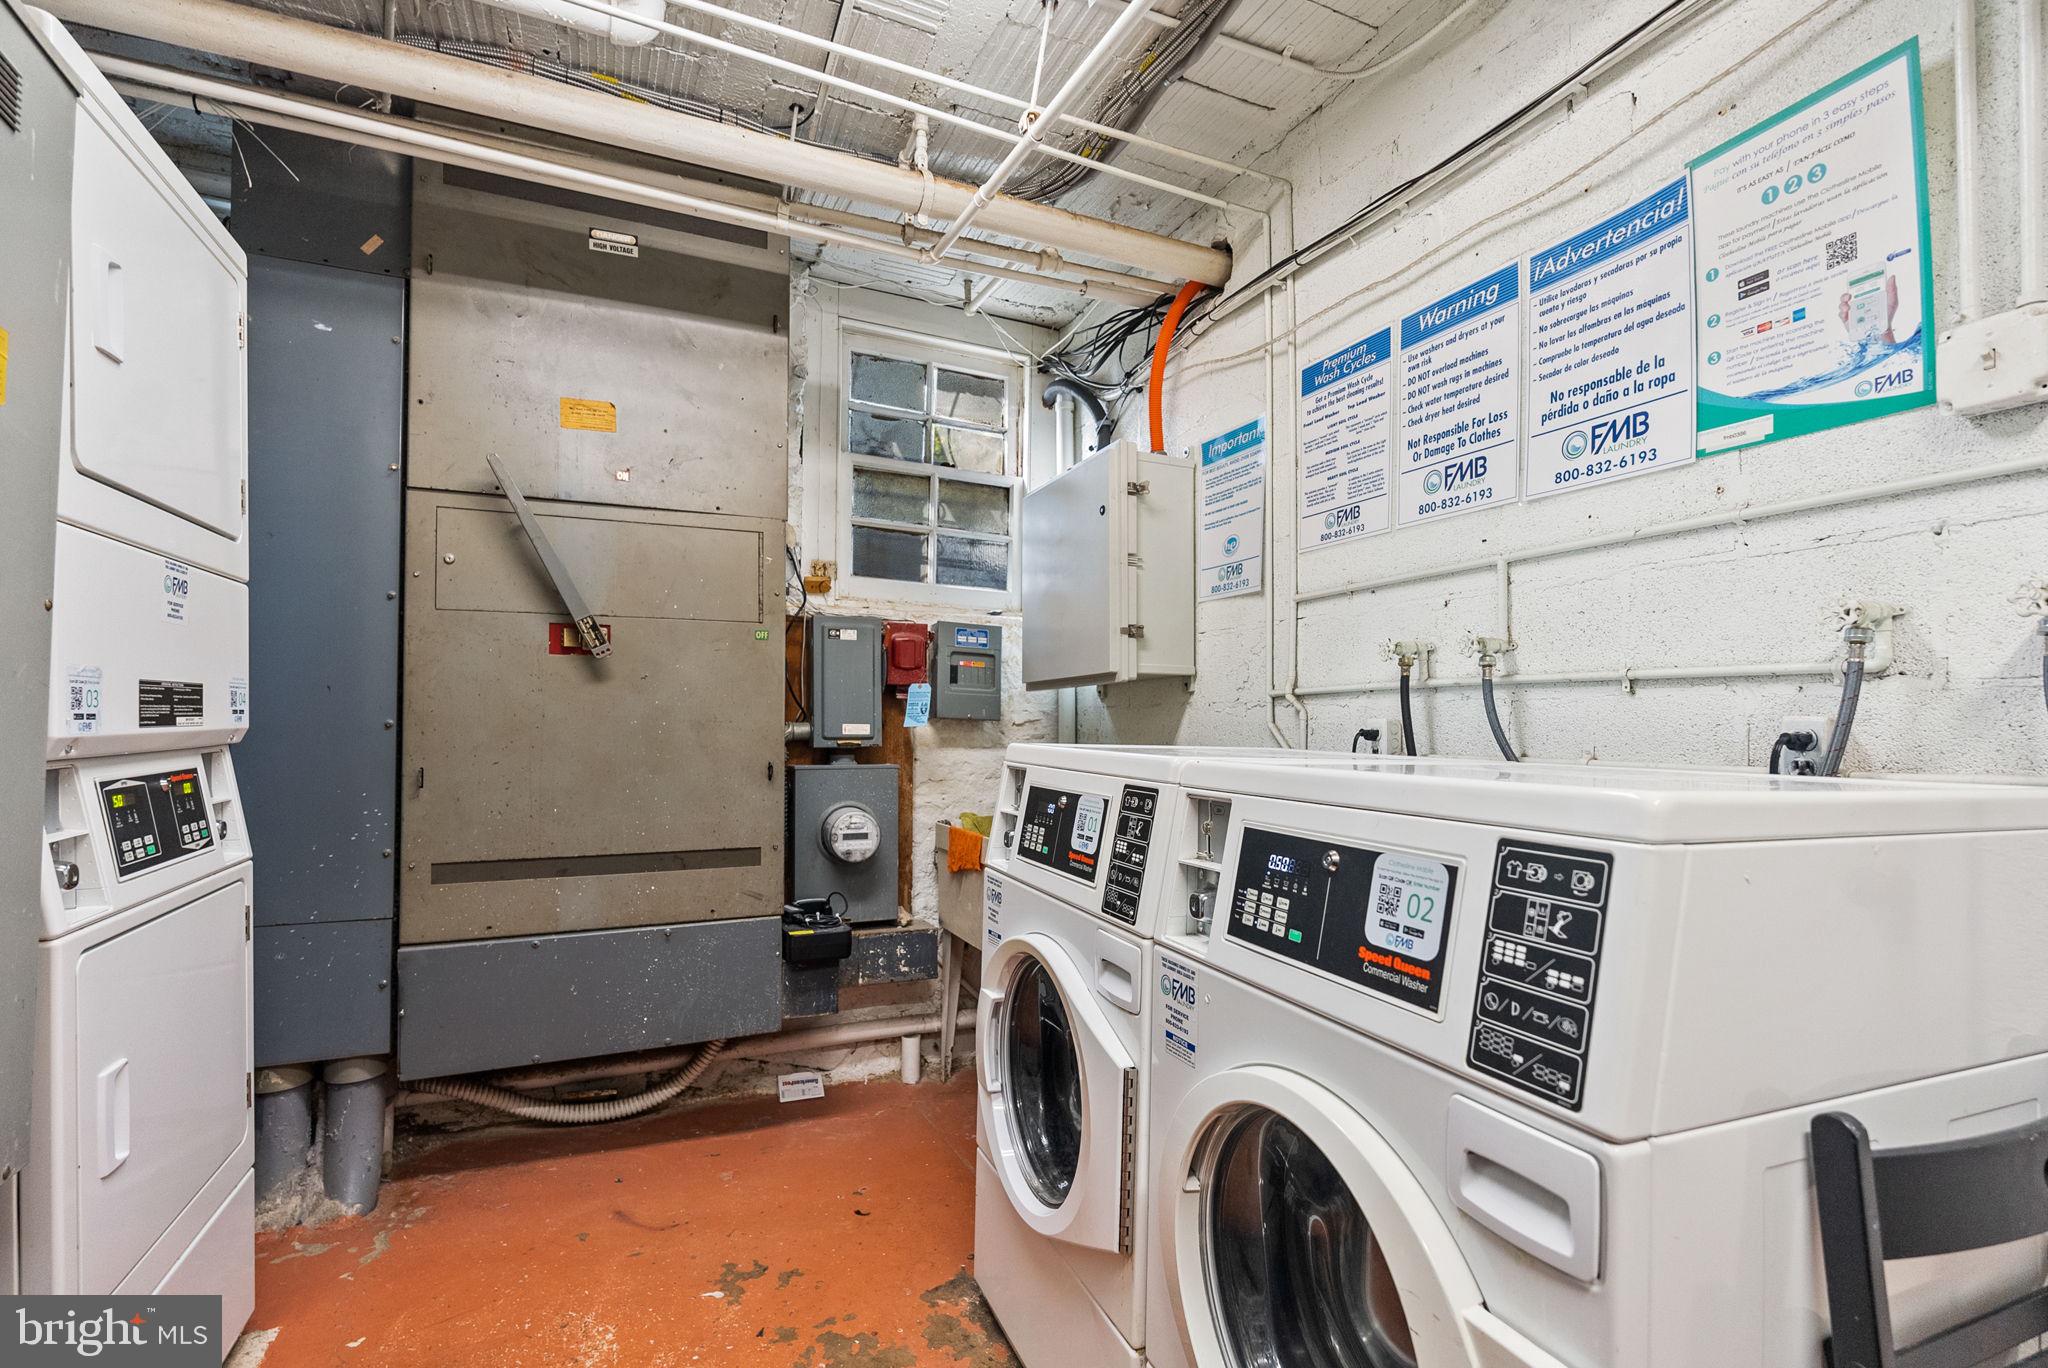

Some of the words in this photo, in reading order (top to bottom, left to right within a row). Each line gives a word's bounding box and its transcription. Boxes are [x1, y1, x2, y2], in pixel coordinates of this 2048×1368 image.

[1714, 166, 1731, 180] Pay
[1732, 154, 1751, 167] with
[1753, 141, 1774, 159] your
[1777, 124, 1809, 146] phone
[1812, 117, 1822, 128] in
[1824, 109, 1830, 120] 3
[1833, 98, 1857, 115] easy
[1860, 81, 1889, 100] steps
[1732, 168, 1747, 180] con
[1750, 161, 1760, 171] su
[1803, 133, 1814, 144] en
[1825, 107, 1863, 132] simples
[1866, 91, 1896, 115] pasos
[1767, 189, 1774, 202] 1
[1789, 177, 1798, 191] 2
[1813, 166, 1822, 181] 3
[593, 242, 607, 250] HIGH
[609, 244, 633, 254] VOLTAGE
[1539, 294, 1559, 307] Utilice
[1560, 279, 1592, 300] lavadoras
[1594, 275, 1598, 284] y
[1600, 260, 1634, 279] secadoras
[1636, 254, 1648, 267] por
[1650, 249, 1658, 257] su
[1660, 235, 1683, 254] propia
[1420, 283, 1499, 331] Warning
[1539, 305, 1559, 317] cuenta
[1561, 302, 1565, 311] y
[1567, 293, 1587, 306] riesgo
[1539, 325, 1548, 333] No
[1550, 308, 1588, 329] sobrecargue
[1589, 304, 1599, 313] las
[1407, 354, 1418, 363] Use
[1420, 342, 1444, 357] washers
[1446, 335, 1456, 346] and
[1458, 327, 1478, 341] dryers
[1481, 322, 1487, 331] at
[1490, 315, 1505, 329] your
[1539, 340, 1548, 349] No
[1550, 334, 1566, 344] lavar
[1567, 329, 1577, 339] las
[1579, 316, 1612, 335] alfombras
[1614, 312, 1622, 320] en
[1624, 306, 1634, 316] las
[1539, 348, 1572, 366] Compruebe
[1574, 344, 1580, 352] la
[1582, 329, 1622, 350] temperatura
[1624, 321, 1634, 332] del
[1637, 317, 1654, 329] agua
[1655, 303, 1685, 320] deseada
[1315, 367, 1339, 386] Wash
[1344, 352, 1376, 373] Cycles
[1323, 344, 1366, 372] Premium
[1408, 363, 1420, 373] own
[1421, 356, 1432, 367] risk
[1408, 377, 1416, 386] DO
[1418, 370, 1430, 382] NOT
[1432, 358, 1457, 376] overload
[1460, 348, 1488, 365] machines
[1539, 369, 1562, 381] Secador
[1591, 347, 1619, 363] deseado
[1328, 387, 1346, 398] Premium
[1347, 381, 1359, 389] Wash
[1361, 374, 1373, 384] Cycle
[1408, 390, 1416, 399] DO
[1418, 384, 1430, 396] NOT
[1432, 378, 1447, 390] wash
[1450, 374, 1462, 386] rugs
[1464, 370, 1470, 378] in
[1472, 358, 1502, 375] machines
[1408, 404, 1423, 414] Check
[1425, 395, 1441, 407] water
[1444, 379, 1482, 400] temperature
[1484, 368, 1509, 385] desired
[1550, 390, 1564, 403] No
[1568, 367, 1632, 398] responsable
[1636, 360, 1650, 375] de
[1654, 355, 1665, 369] la
[1875, 369, 1913, 393] FMB
[1312, 404, 1327, 414] achieve
[1336, 395, 1345, 403] best
[1347, 387, 1364, 399] cleaning
[1366, 377, 1383, 390] results!
[1408, 418, 1423, 428] Check
[1425, 411, 1440, 421] dryer
[1442, 405, 1455, 415] heat
[1457, 394, 1480, 409] desired
[1541, 403, 1579, 426] pérdida
[1583, 400, 1589, 410] o
[1593, 389, 1618, 406] daño
[1623, 387, 1629, 397] a
[1634, 380, 1644, 394] la
[1649, 372, 1676, 390] ropa
[1325, 410, 1339, 419] Washer
[1407, 438, 1420, 450] Not
[1423, 421, 1469, 445] Responsible
[1472, 416, 1485, 429] For
[1489, 411, 1508, 423] Loss
[1413, 452, 1421, 462] Or
[1425, 443, 1454, 458] Damage
[1458, 437, 1466, 448] To
[1470, 428, 1501, 444] Clothes
[1591, 411, 1649, 455] FMB
[1603, 436, 1648, 454] LAUNDRY
[617, 471, 629, 481] ON
[1445, 456, 1487, 491] FMB
[1555, 448, 1657, 484] 800-832-6193
[1454, 477, 1485, 491] LAUNDRY
[1337, 505, 1360, 527] FMB
[1419, 488, 1492, 514] 800-832-6193
[1320, 524, 1364, 541] 800-832-6193
[173, 577, 188, 595] FMB
[1211, 579, 1249, 593] 800-832-6193
[1226, 563, 1242, 580] FMB
[756, 631, 768, 639] OFF
[87, 689, 98, 707] 03
[1088, 817, 1097, 832] 01
[1407, 893, 1434, 923] 02
[1395, 935, 1413, 949] FMB
[1358, 946, 1392, 967] Speed
[1394, 957, 1431, 980] Queen
[1363, 962, 1401, 983] Commercial
[1402, 976, 1428, 993] Washer
[1172, 978, 1195, 1004] FMB
